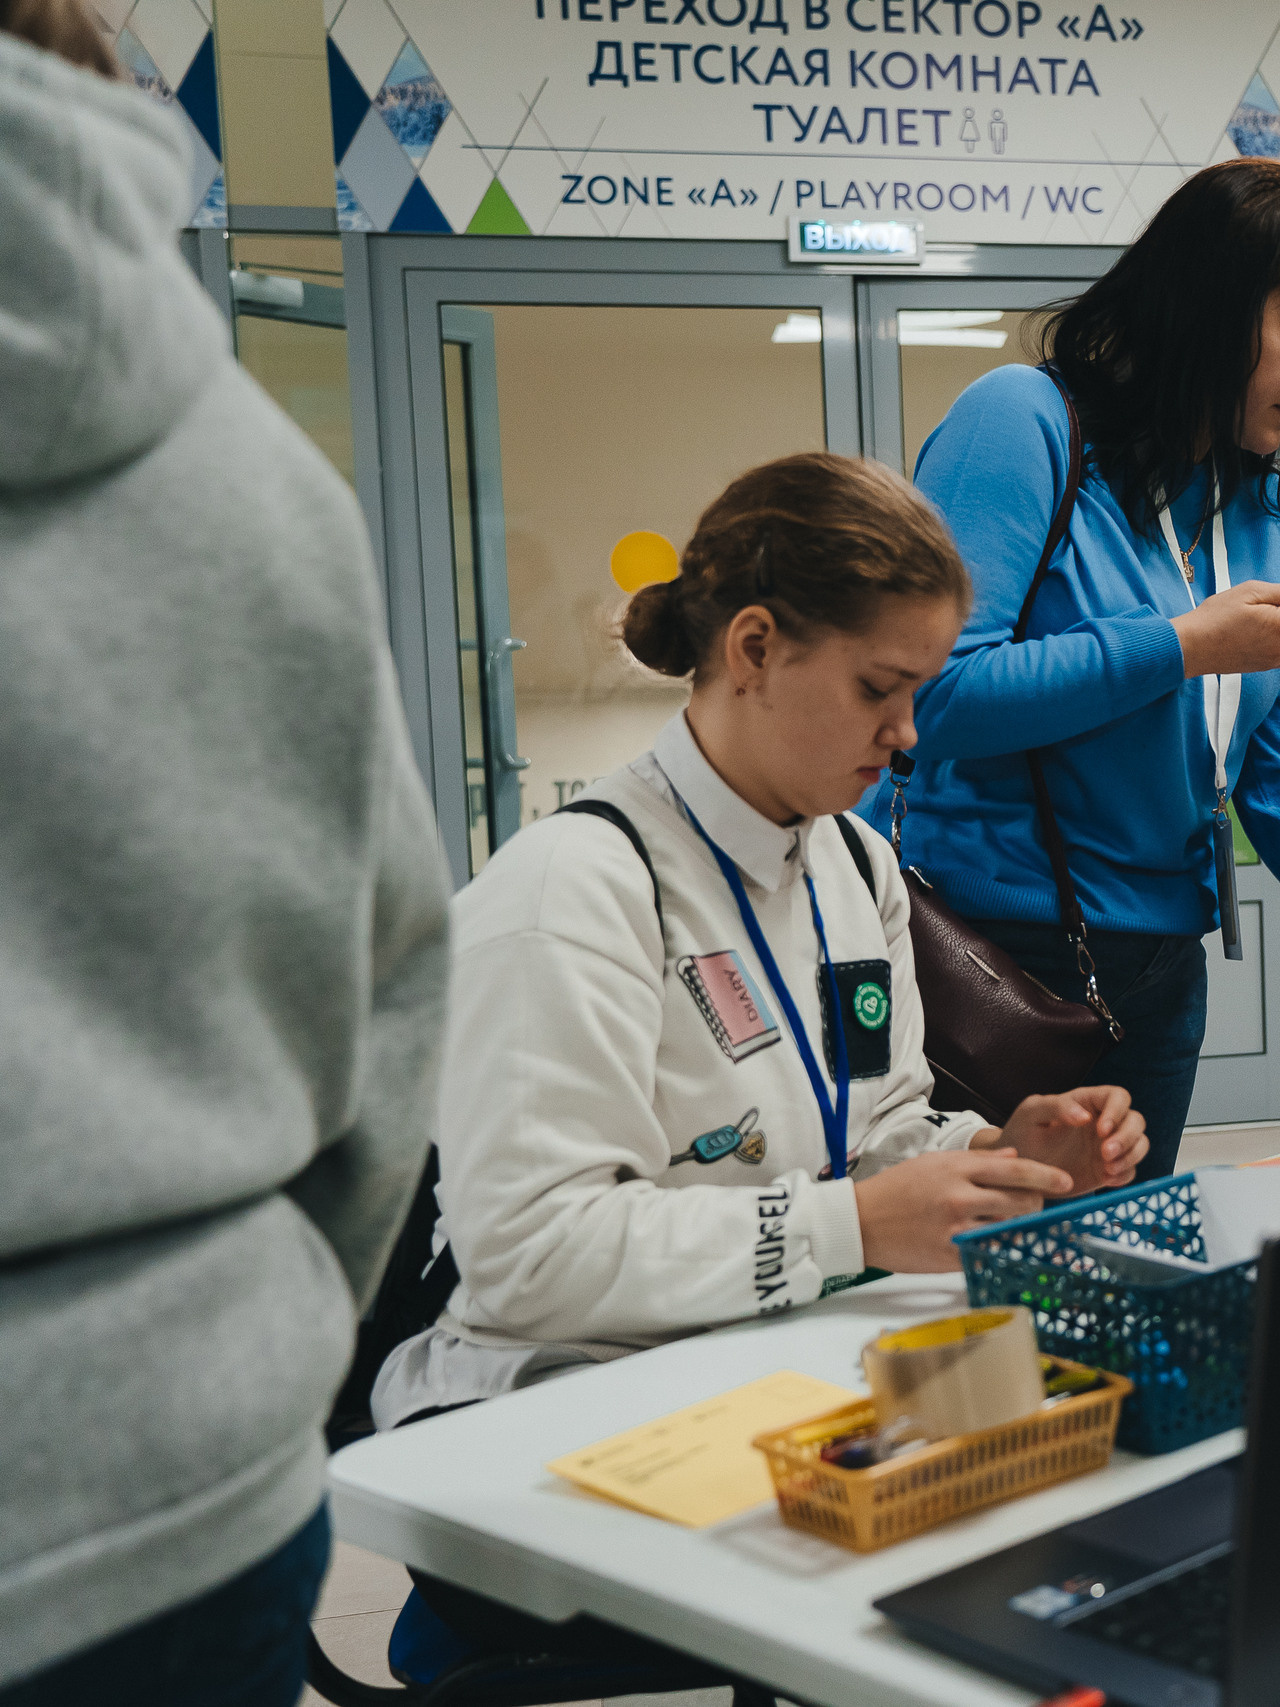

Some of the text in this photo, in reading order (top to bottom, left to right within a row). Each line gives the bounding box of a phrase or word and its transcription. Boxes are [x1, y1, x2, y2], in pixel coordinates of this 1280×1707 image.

[804, 0, 830, 31] В
[846, 0, 1042, 38] СЕКТОР
[1056, 4, 1144, 42] «А»
[588, 41, 1100, 96] ДЕТСКАЯ КОМНАТА
[753, 104, 951, 146] ТУАЛЕТ
[561, 174, 674, 206] ZONE
[687, 178, 758, 207] «A»
[795, 180, 1009, 213] PLAYROOM
[1043, 185, 1104, 214] WC
[803, 224, 911, 253] ВЫХОД
[723, 969, 758, 1022] DIARY
